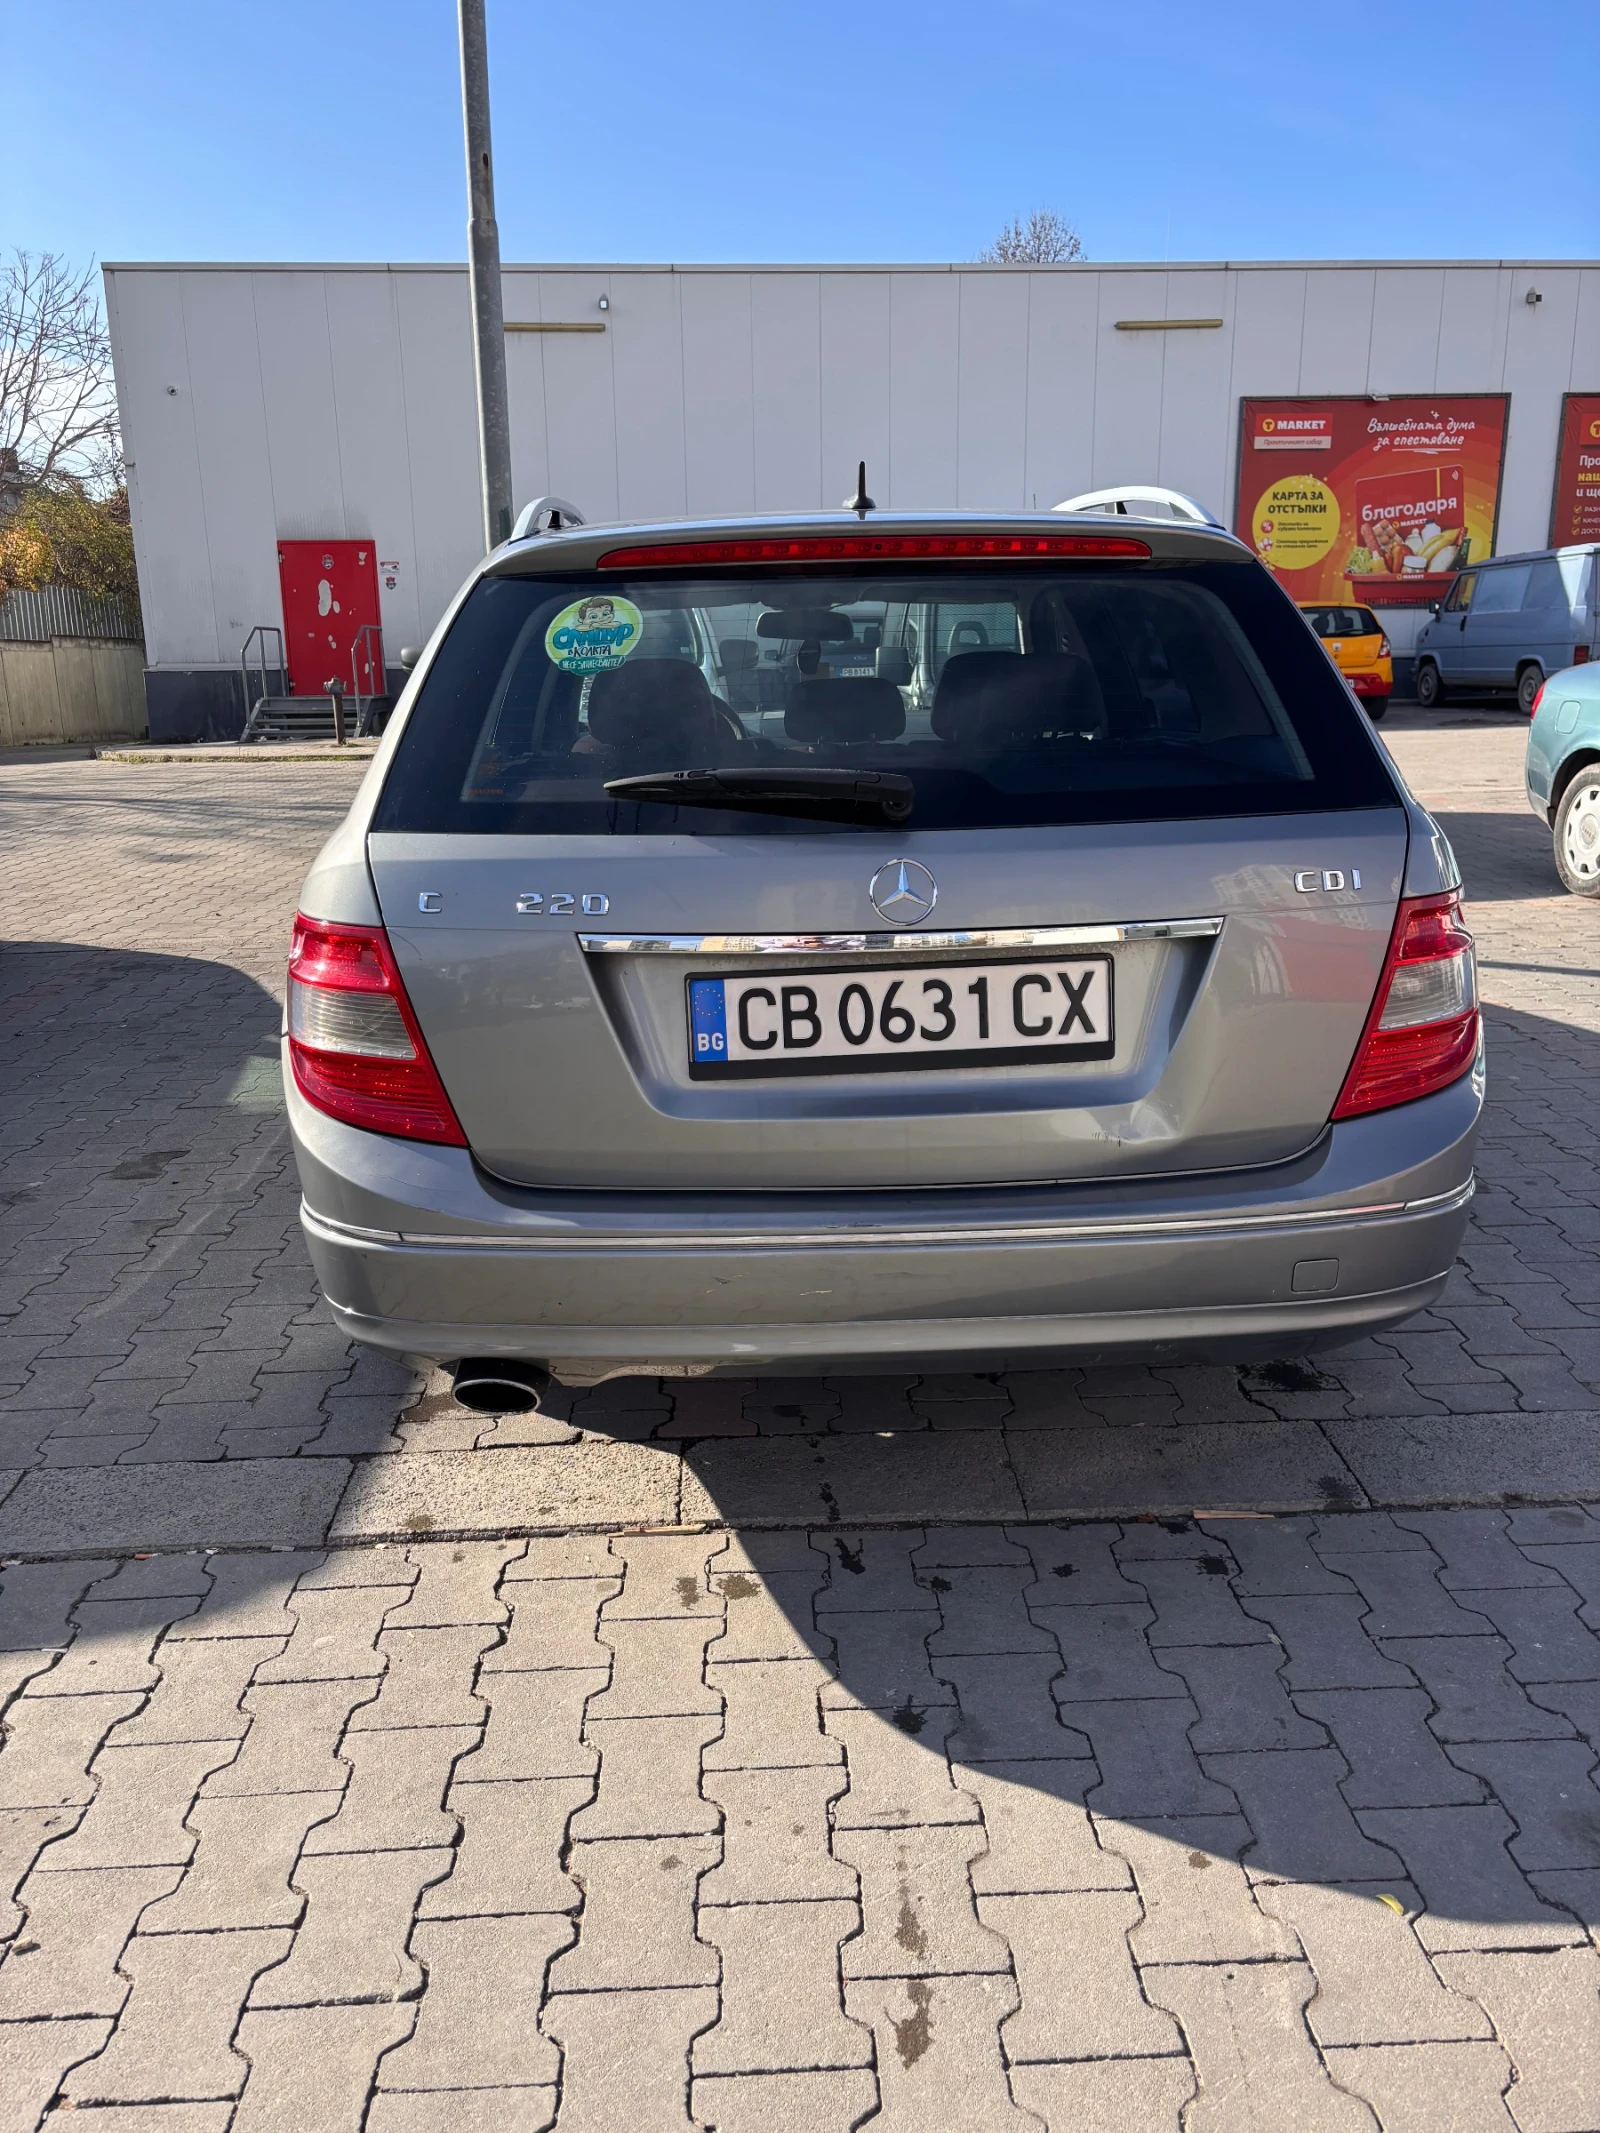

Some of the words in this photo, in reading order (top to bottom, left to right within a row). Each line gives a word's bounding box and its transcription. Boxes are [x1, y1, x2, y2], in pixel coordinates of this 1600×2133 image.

[1277, 420, 1326, 430] MARKET
[1367, 417, 1443, 433] Вълшебната
[1446, 417, 1475, 434] дума
[1372, 437, 1390, 452] за
[1393, 431, 1465, 445] спестяване
[1272, 491, 1308, 501] КАРТА
[1310, 491, 1324, 501] ЗА
[1576, 488, 1583, 497] и
[1268, 504, 1327, 514] ОТСТЪПКИ
[1361, 497, 1457, 521] благодаря
[1400, 519, 1427, 527] MARKET
[573, 644, 613, 658] КОЛАТА
[419, 892, 442, 914] C
[516, 893, 609, 915] 220
[1294, 869, 1361, 893] CDI
[738, 985, 823, 1051] CB
[838, 977, 990, 1046] 0631
[1012, 969, 1096, 1037] CX
[697, 1032, 724, 1052] BG
